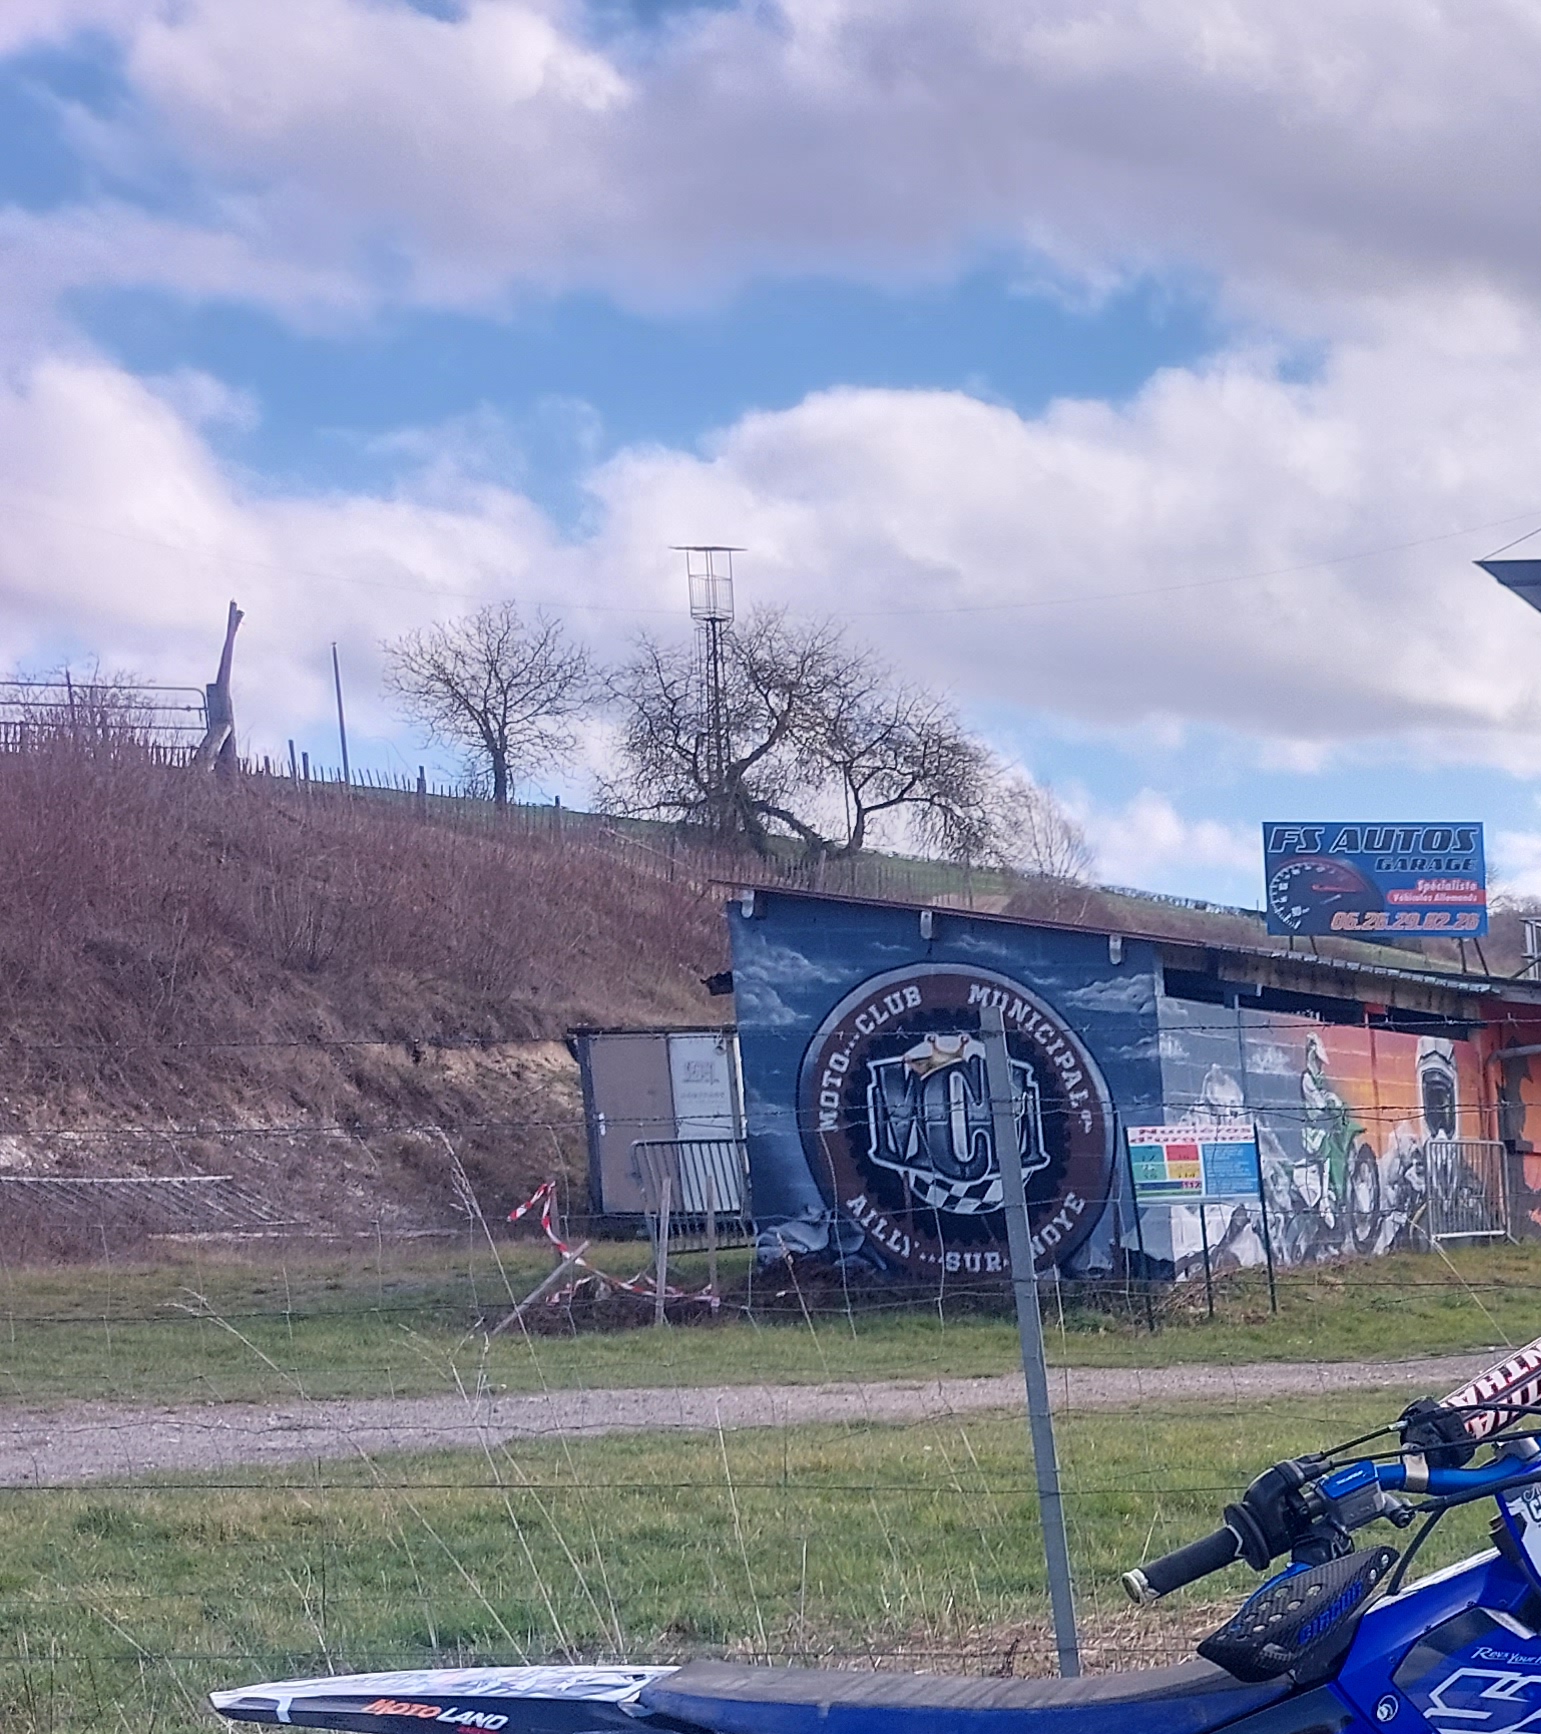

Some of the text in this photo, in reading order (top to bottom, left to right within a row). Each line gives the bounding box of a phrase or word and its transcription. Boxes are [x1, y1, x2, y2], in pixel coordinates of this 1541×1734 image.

[1267, 826, 1479, 854] FS AUTOS
[1375, 856, 1478, 873] GARAGE
[819, 1051, 851, 1133] MOTO
[856, 984, 923, 1035] CLUB
[967, 983, 1090, 1109] MUNICIPAL
[945, 1250, 1003, 1273] SUR
[436, 1706, 510, 1731] LAND
